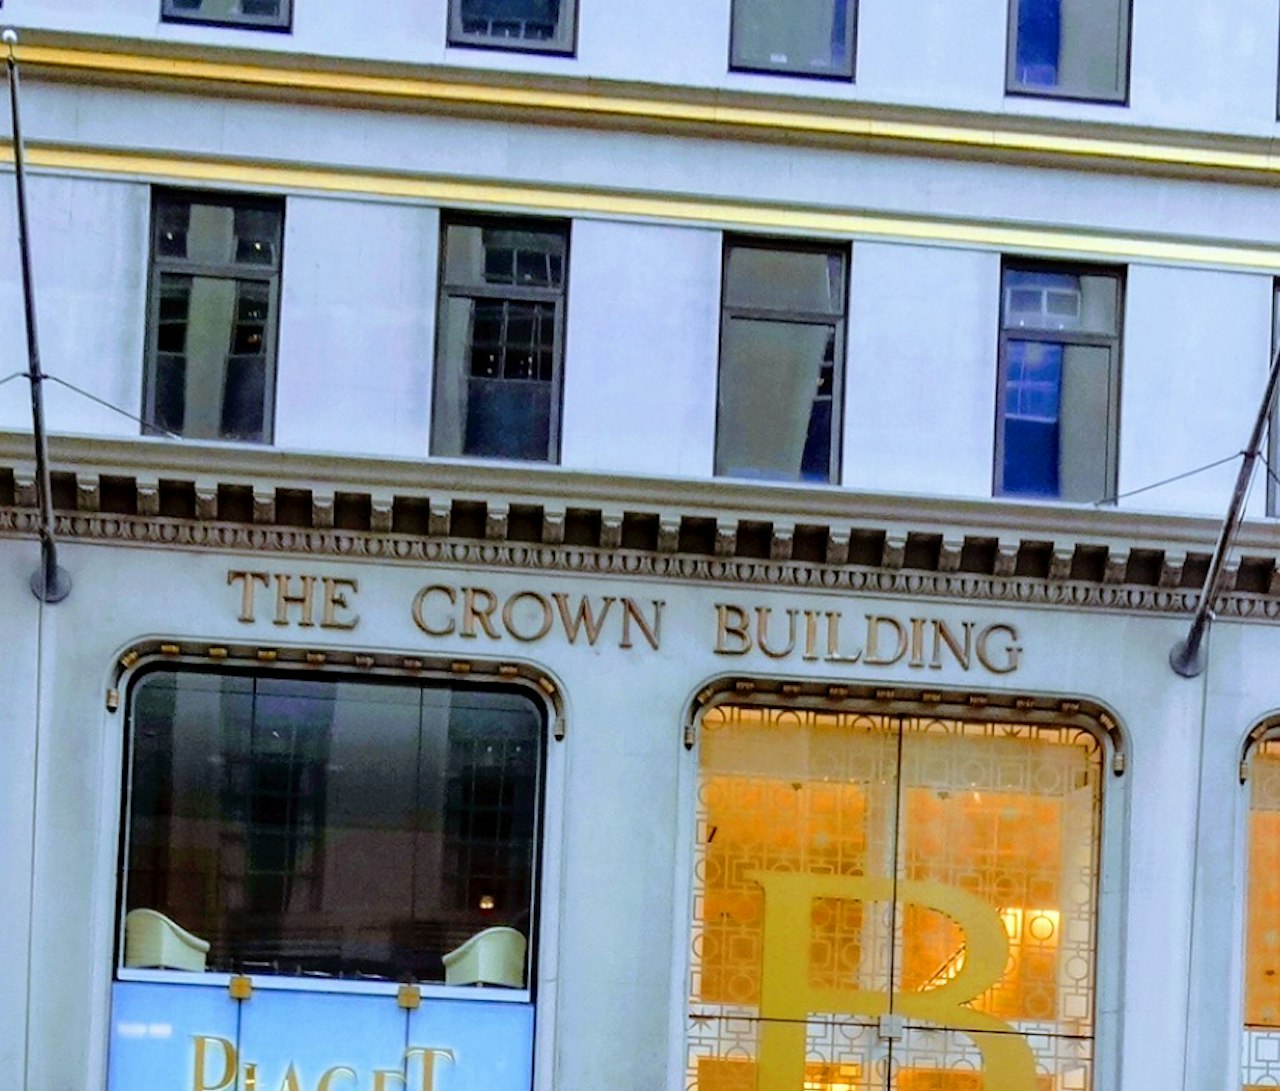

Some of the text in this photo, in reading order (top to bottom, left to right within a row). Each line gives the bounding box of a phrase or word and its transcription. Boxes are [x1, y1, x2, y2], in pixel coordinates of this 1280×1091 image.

[227, 569, 1025, 674] THE CROWN BUILDING
